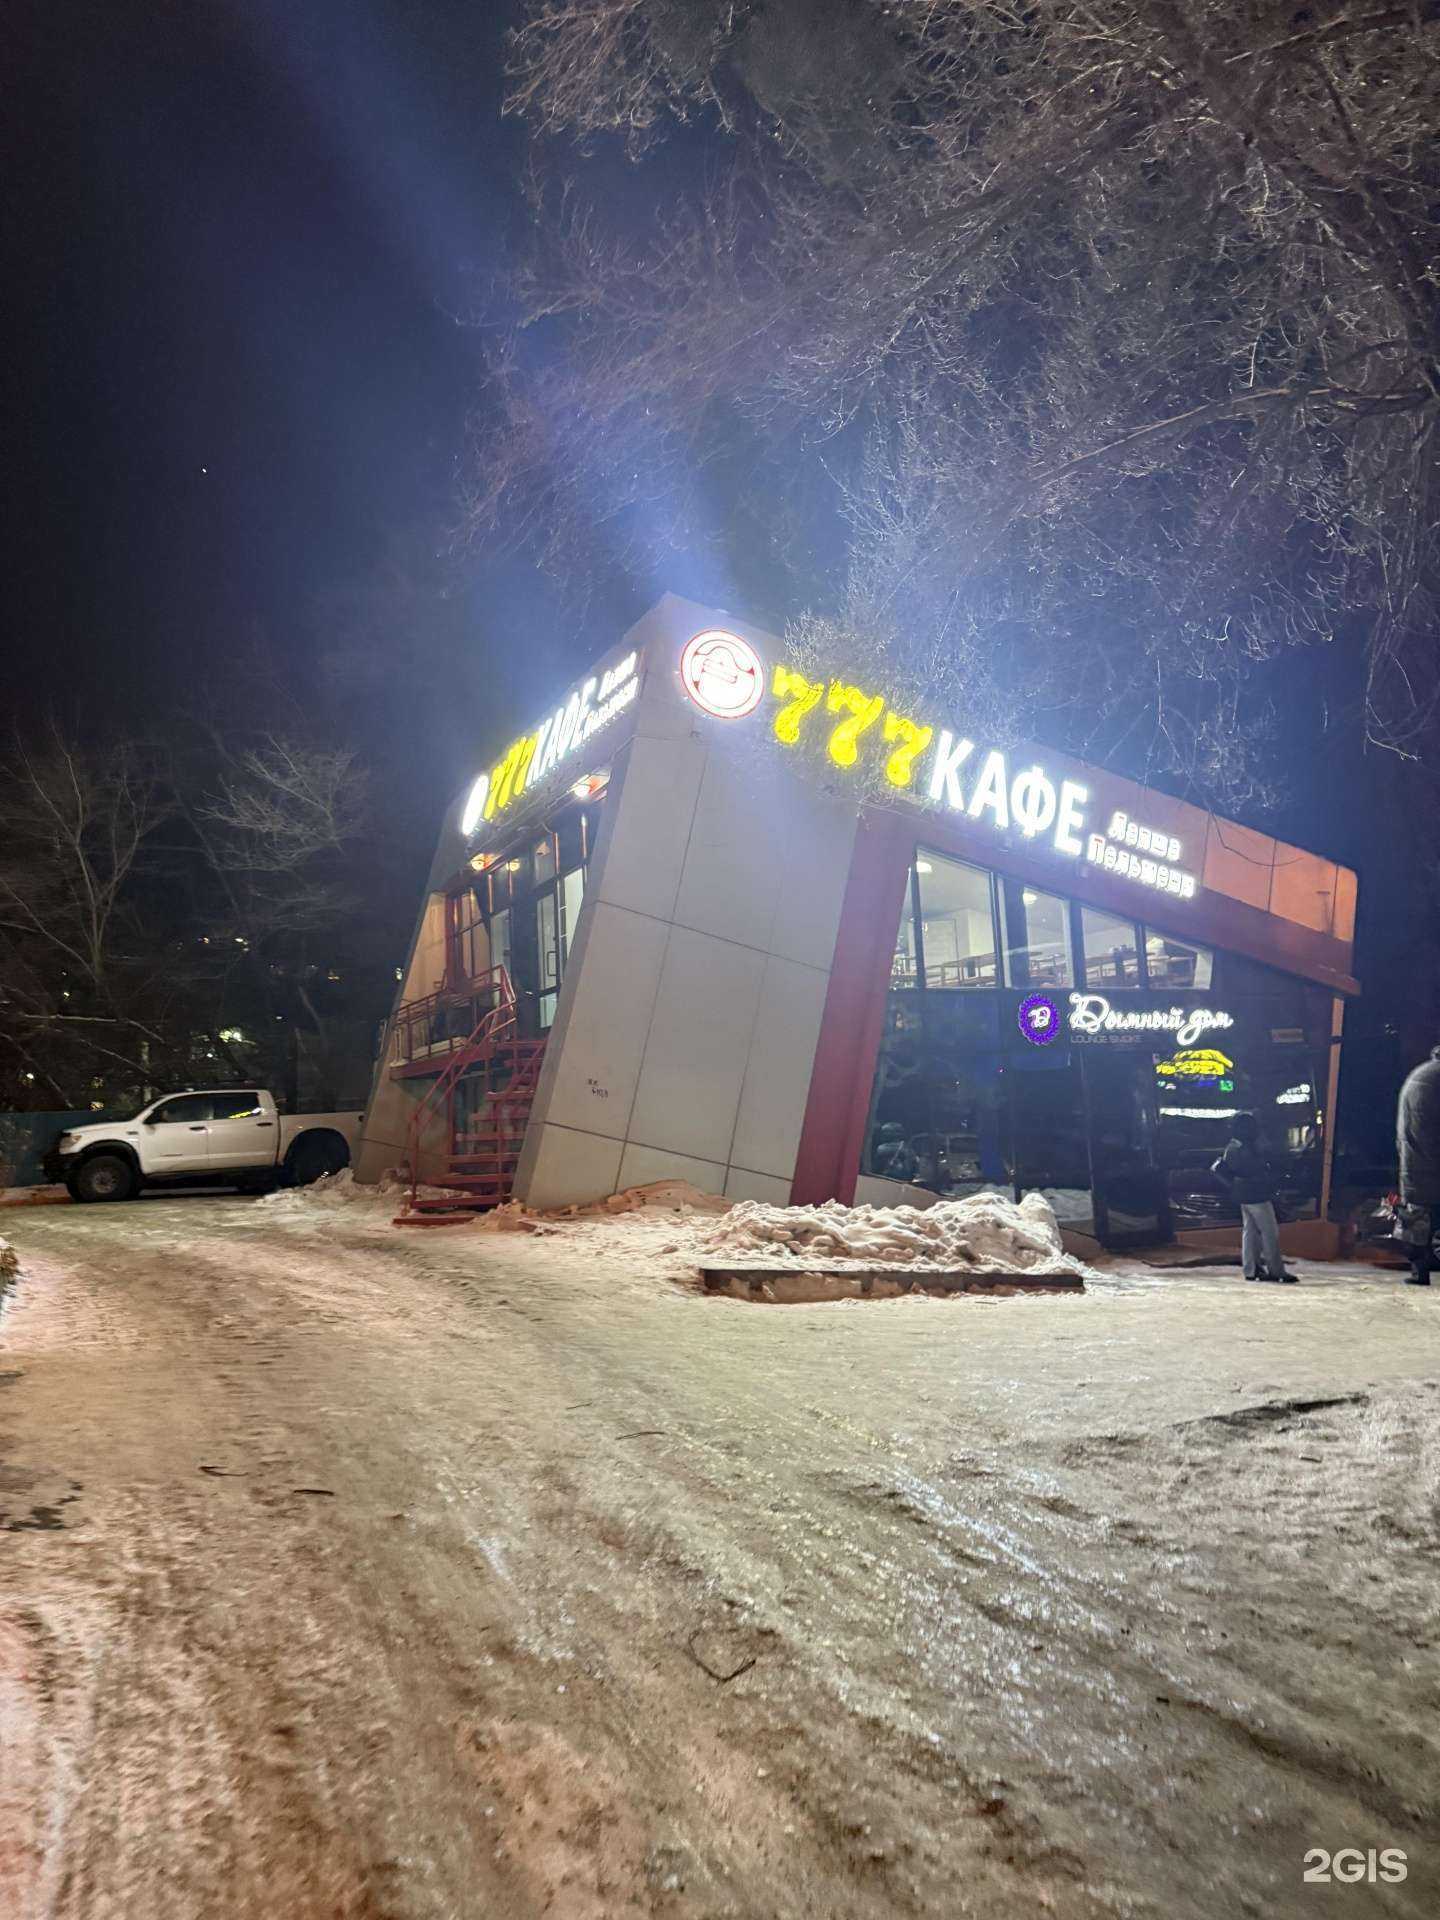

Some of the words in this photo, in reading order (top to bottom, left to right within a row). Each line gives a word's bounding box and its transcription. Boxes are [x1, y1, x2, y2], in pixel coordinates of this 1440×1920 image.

[772, 666, 933, 786] 777
[928, 729, 1088, 856] КАФЕ
[1087, 833, 1195, 898] Пельмени
[1108, 811, 1181, 861] Лапша
